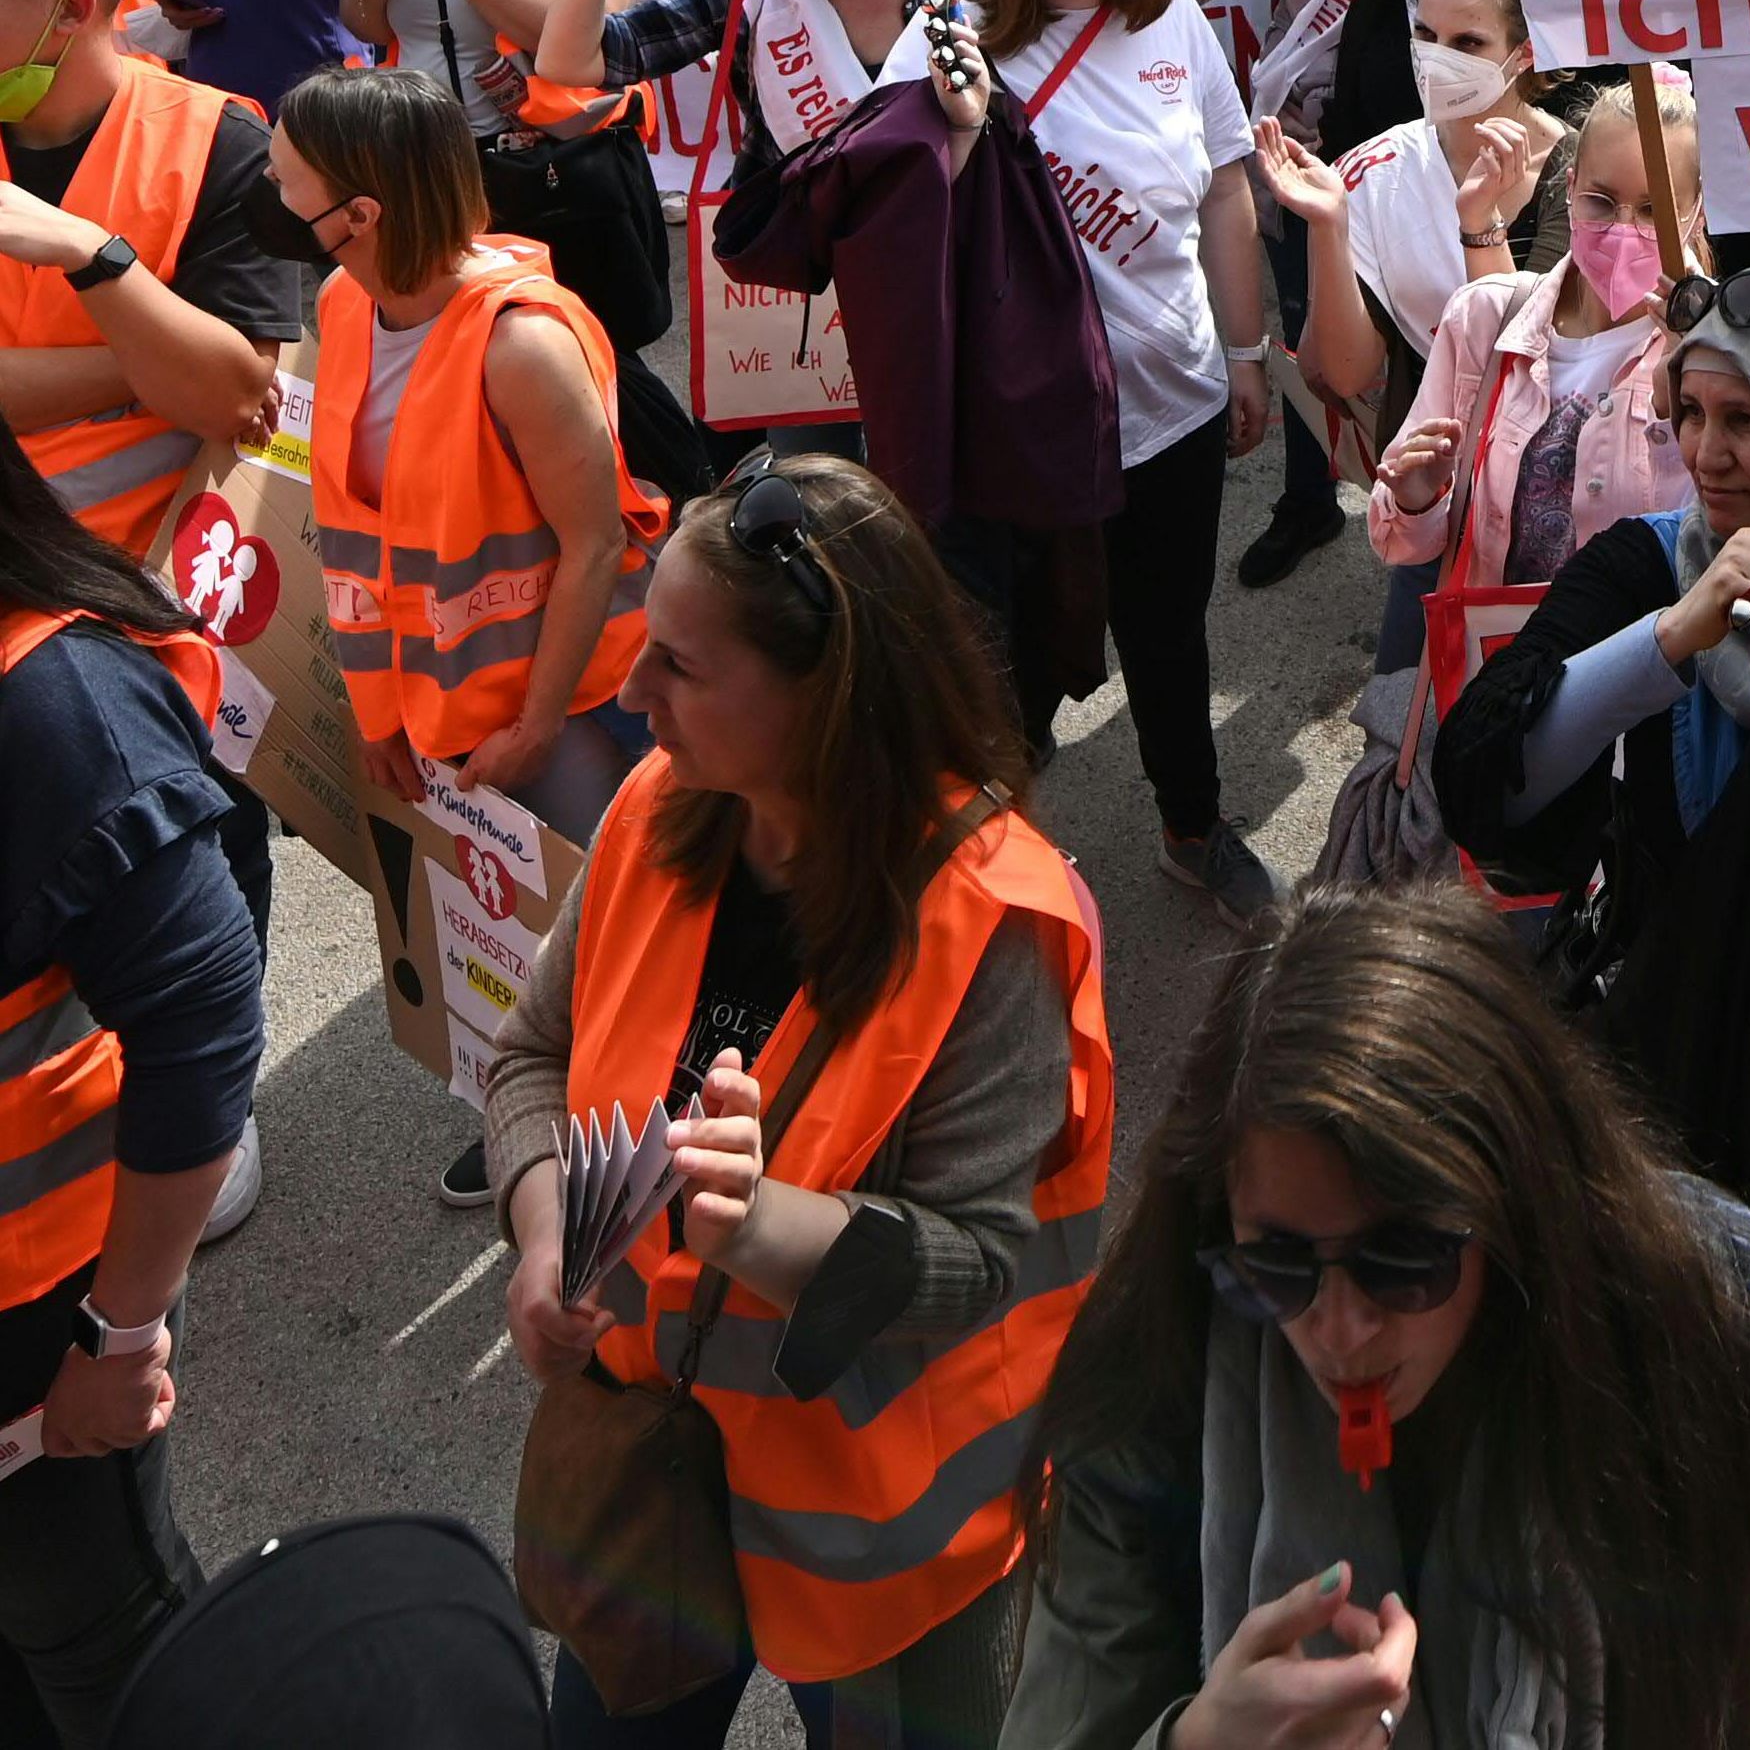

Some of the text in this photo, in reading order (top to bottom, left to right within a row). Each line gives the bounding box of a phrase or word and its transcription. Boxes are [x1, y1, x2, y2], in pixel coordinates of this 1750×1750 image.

[767, 23, 812, 75] Es
[1137, 64, 1188, 82] Hard Rock
[728, 348, 823, 374] WIE ICH
[436, 781, 535, 863] Kinderfreunde
[446, 944, 466, 972] der
